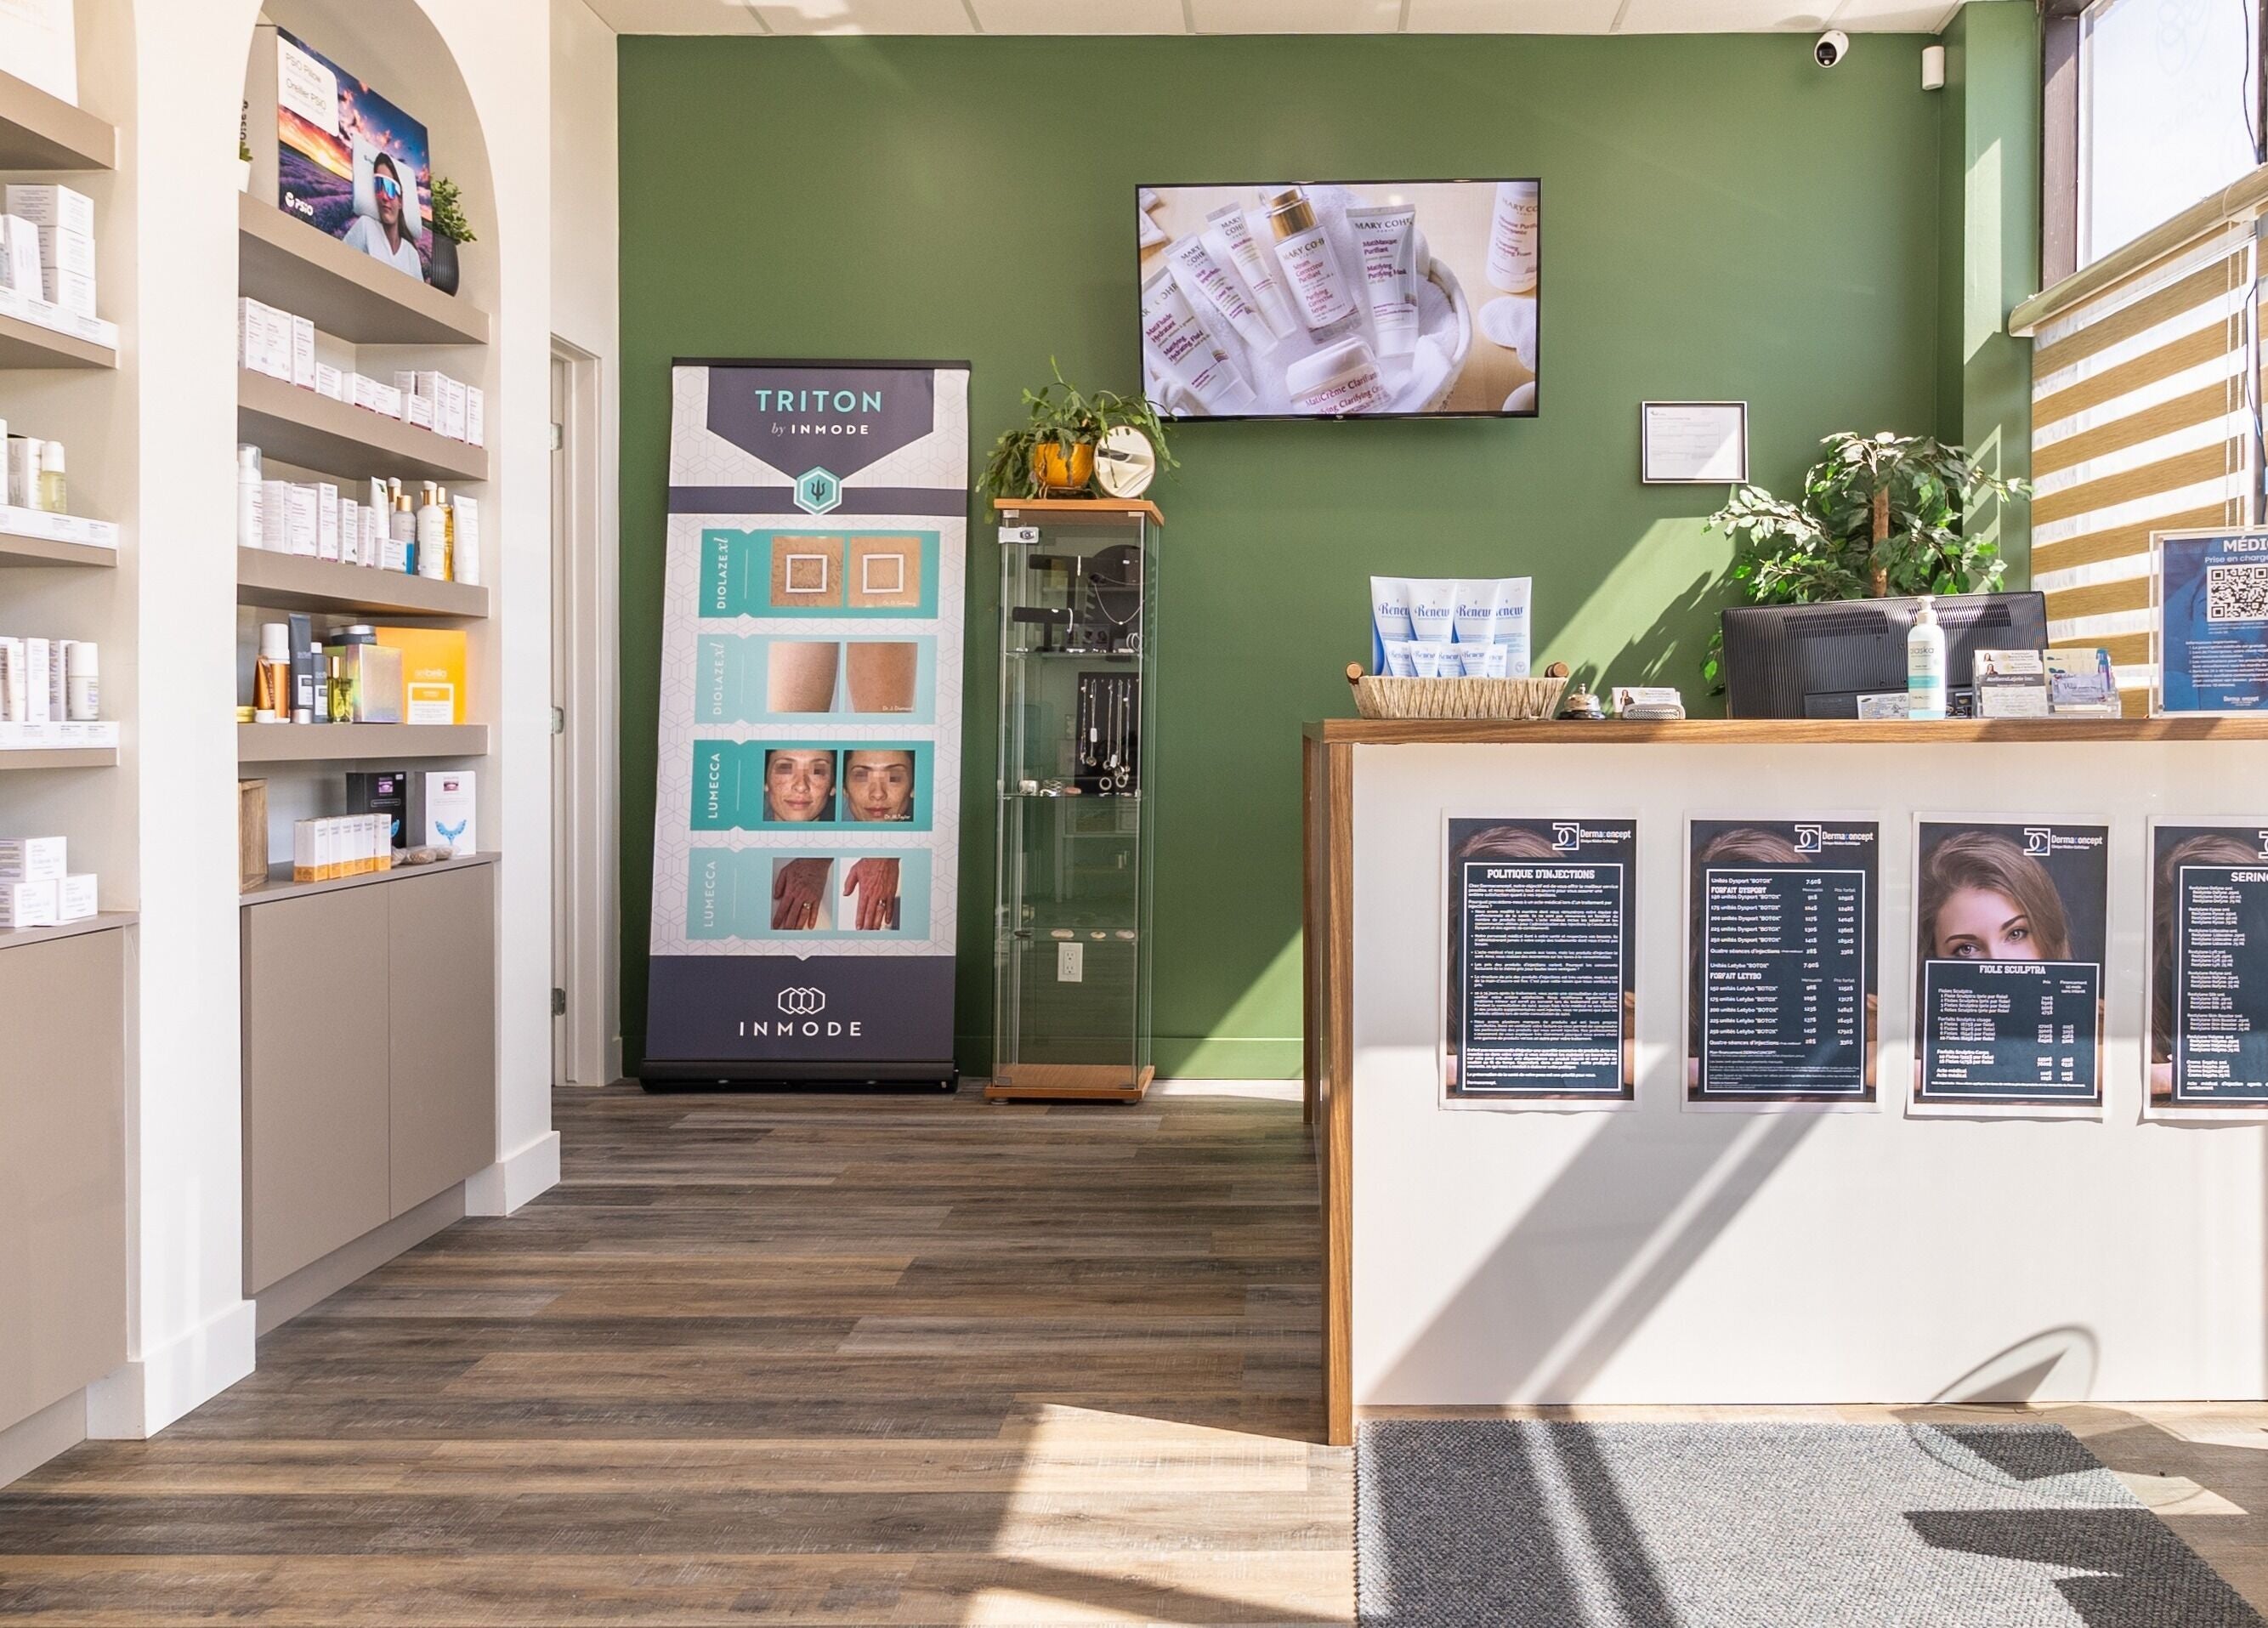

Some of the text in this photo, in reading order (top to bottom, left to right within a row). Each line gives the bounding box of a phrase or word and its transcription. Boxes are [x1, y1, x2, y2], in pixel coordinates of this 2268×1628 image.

[1221, 217, 1242, 229] MARY
[1355, 220, 1382, 231] MARY
[1181, 245, 1200, 260] MARY
[1367, 263, 1392, 272] Matifying
[1369, 270, 1393, 280] Purifying
[1164, 336, 1187, 356] Matifying
[1168, 341, 1193, 362] Hydrating
[755, 389, 882, 412] TRITON
[1339, 389, 1372, 408] Clarifying
[771, 423, 869, 437] by INMODE
[2223, 536, 2268, 553] MÉDI
[1415, 604, 1449, 617] Renew
[1456, 604, 1491, 617] Renew
[1495, 606, 1524, 616] enew
[1462, 650, 1485, 659] Renew
[707, 752, 721, 819] LUMECCA
[1487, 869, 1595, 879] POLITIQUE D'INJECTIONS
[2231, 872, 2268, 882] SERIN
[704, 861, 716, 927] LUMECCA
[1979, 965, 2046, 974] FIOLE SCULPTRA
[740, 1021, 861, 1036] INMODE
